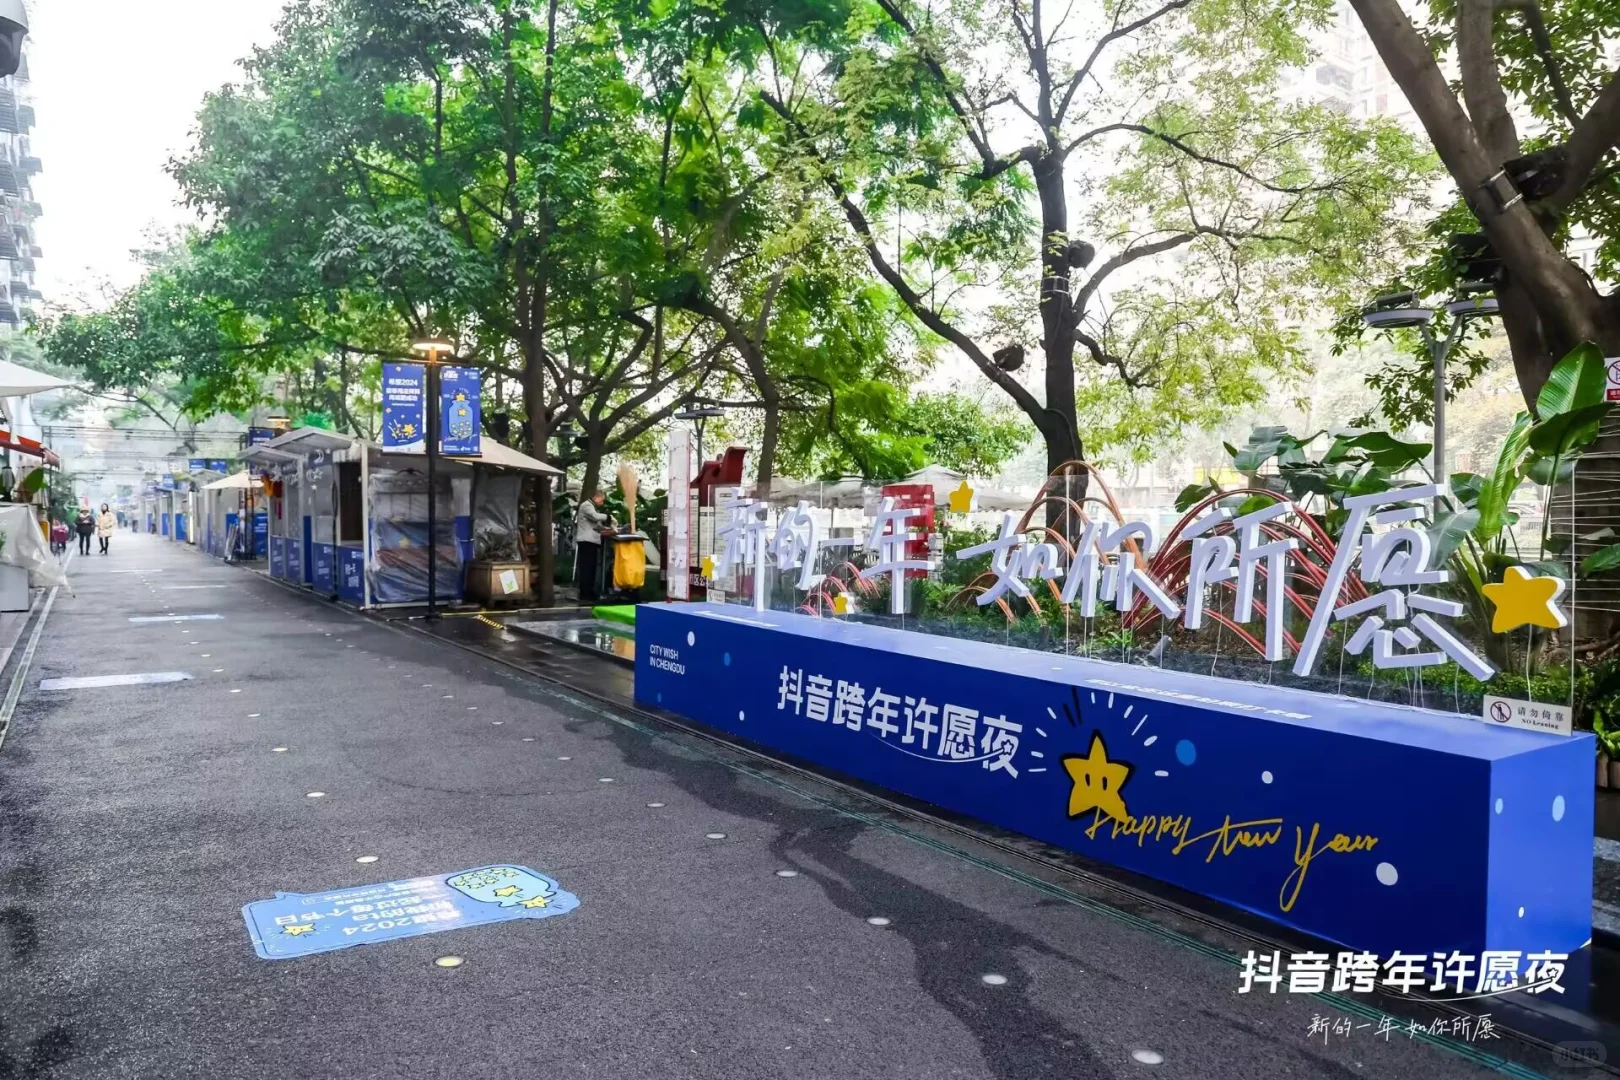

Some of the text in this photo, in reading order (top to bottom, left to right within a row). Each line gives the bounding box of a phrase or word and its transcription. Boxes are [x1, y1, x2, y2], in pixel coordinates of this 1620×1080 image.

[714, 487, 935, 614] 新的一年
[956, 483, 1497, 681] 如你所愿
[649, 644, 679, 660] CITY WISH
[649, 656, 686, 675] IN CHENGDU
[777, 665, 1023, 778] 抖音跨年许愿夜
[1279, 822, 1379, 912] Year
